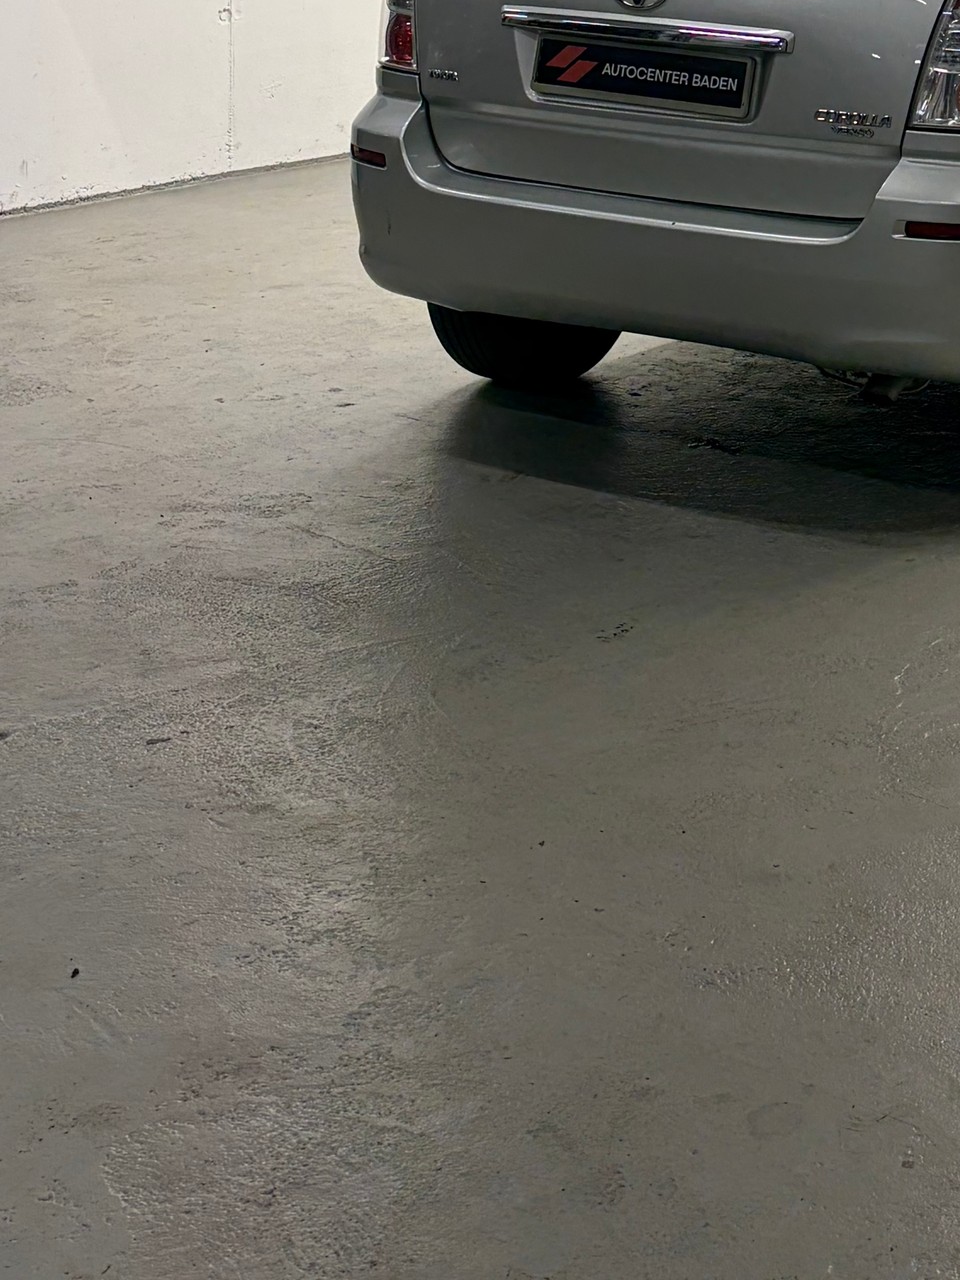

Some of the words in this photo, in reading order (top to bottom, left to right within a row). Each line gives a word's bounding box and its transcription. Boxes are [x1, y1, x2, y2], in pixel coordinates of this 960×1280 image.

[601, 62, 689, 86] AUTOCENTER
[691, 73, 738, 92] BADEN
[814, 108, 892, 129] COROLLA
